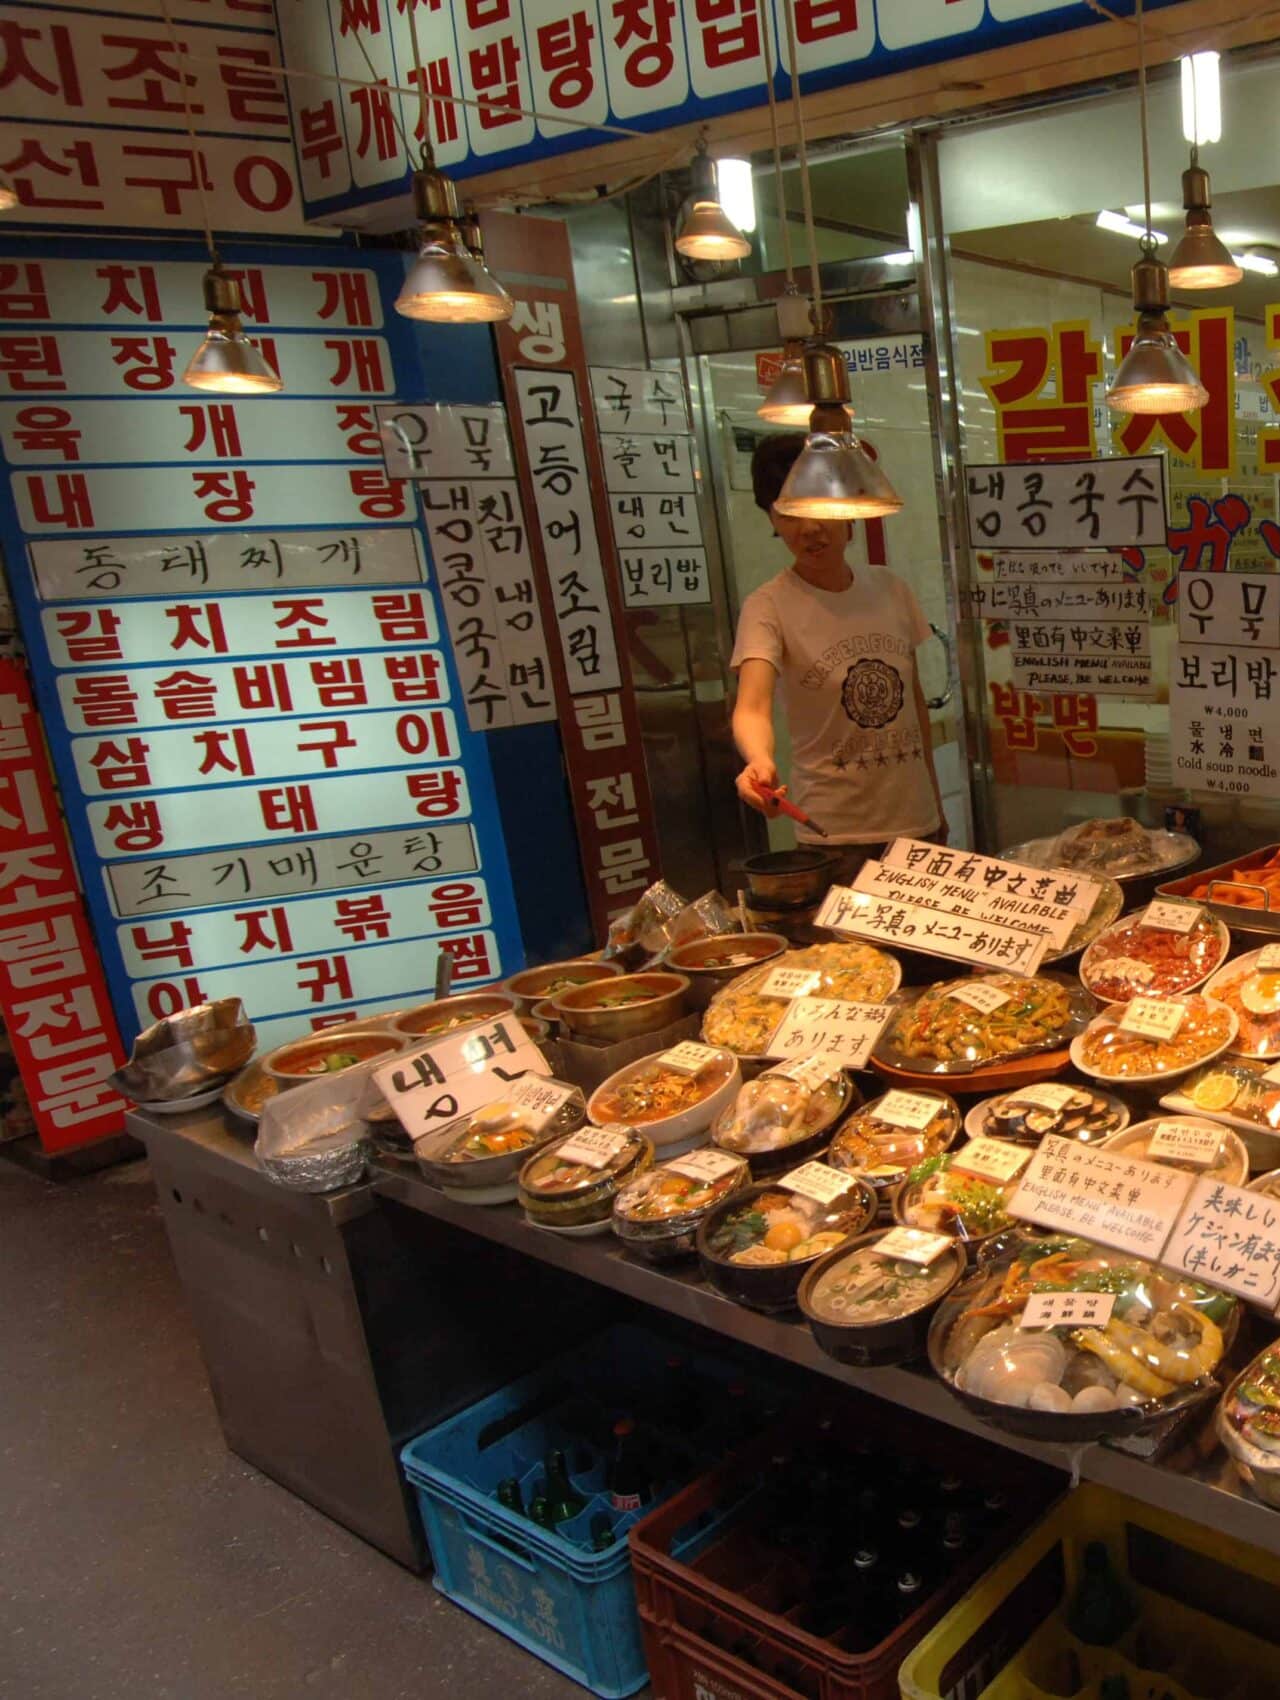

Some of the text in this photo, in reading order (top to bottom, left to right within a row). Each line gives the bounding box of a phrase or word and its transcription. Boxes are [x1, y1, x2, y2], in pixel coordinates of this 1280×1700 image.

[0, 336, 386, 391] 된장개
[844, 344, 926, 372] 일반음식점
[603, 373, 676, 424] 국수
[391, 412, 491, 474] 우묵
[516, 384, 602, 677] 고등어조림
[618, 495, 686, 537] 냉면
[967, 473, 1159, 538] 냉콩국수
[76, 539, 362, 590] 동태찌개
[622, 557, 703, 598] 보리밥
[56, 593, 430, 661] 갈치조림
[425, 484, 495, 726] 냉콩국수
[1186, 578, 1267, 641] 우묵
[72, 654, 441, 729] 돌솥비빔밥
[1176, 654, 1279, 700] 보리밥
[89, 711, 452, 791] 삼치구이
[1189, 720, 1265, 744] 물냉면
[1176, 755, 1278, 779] Cold soup noodle
[103, 772, 461, 852] 생태탕
[136, 832, 448, 906] 조기매운탕
[130, 882, 484, 968] 낙지볶음
[990, 894, 1070, 922] AVAILABLE
